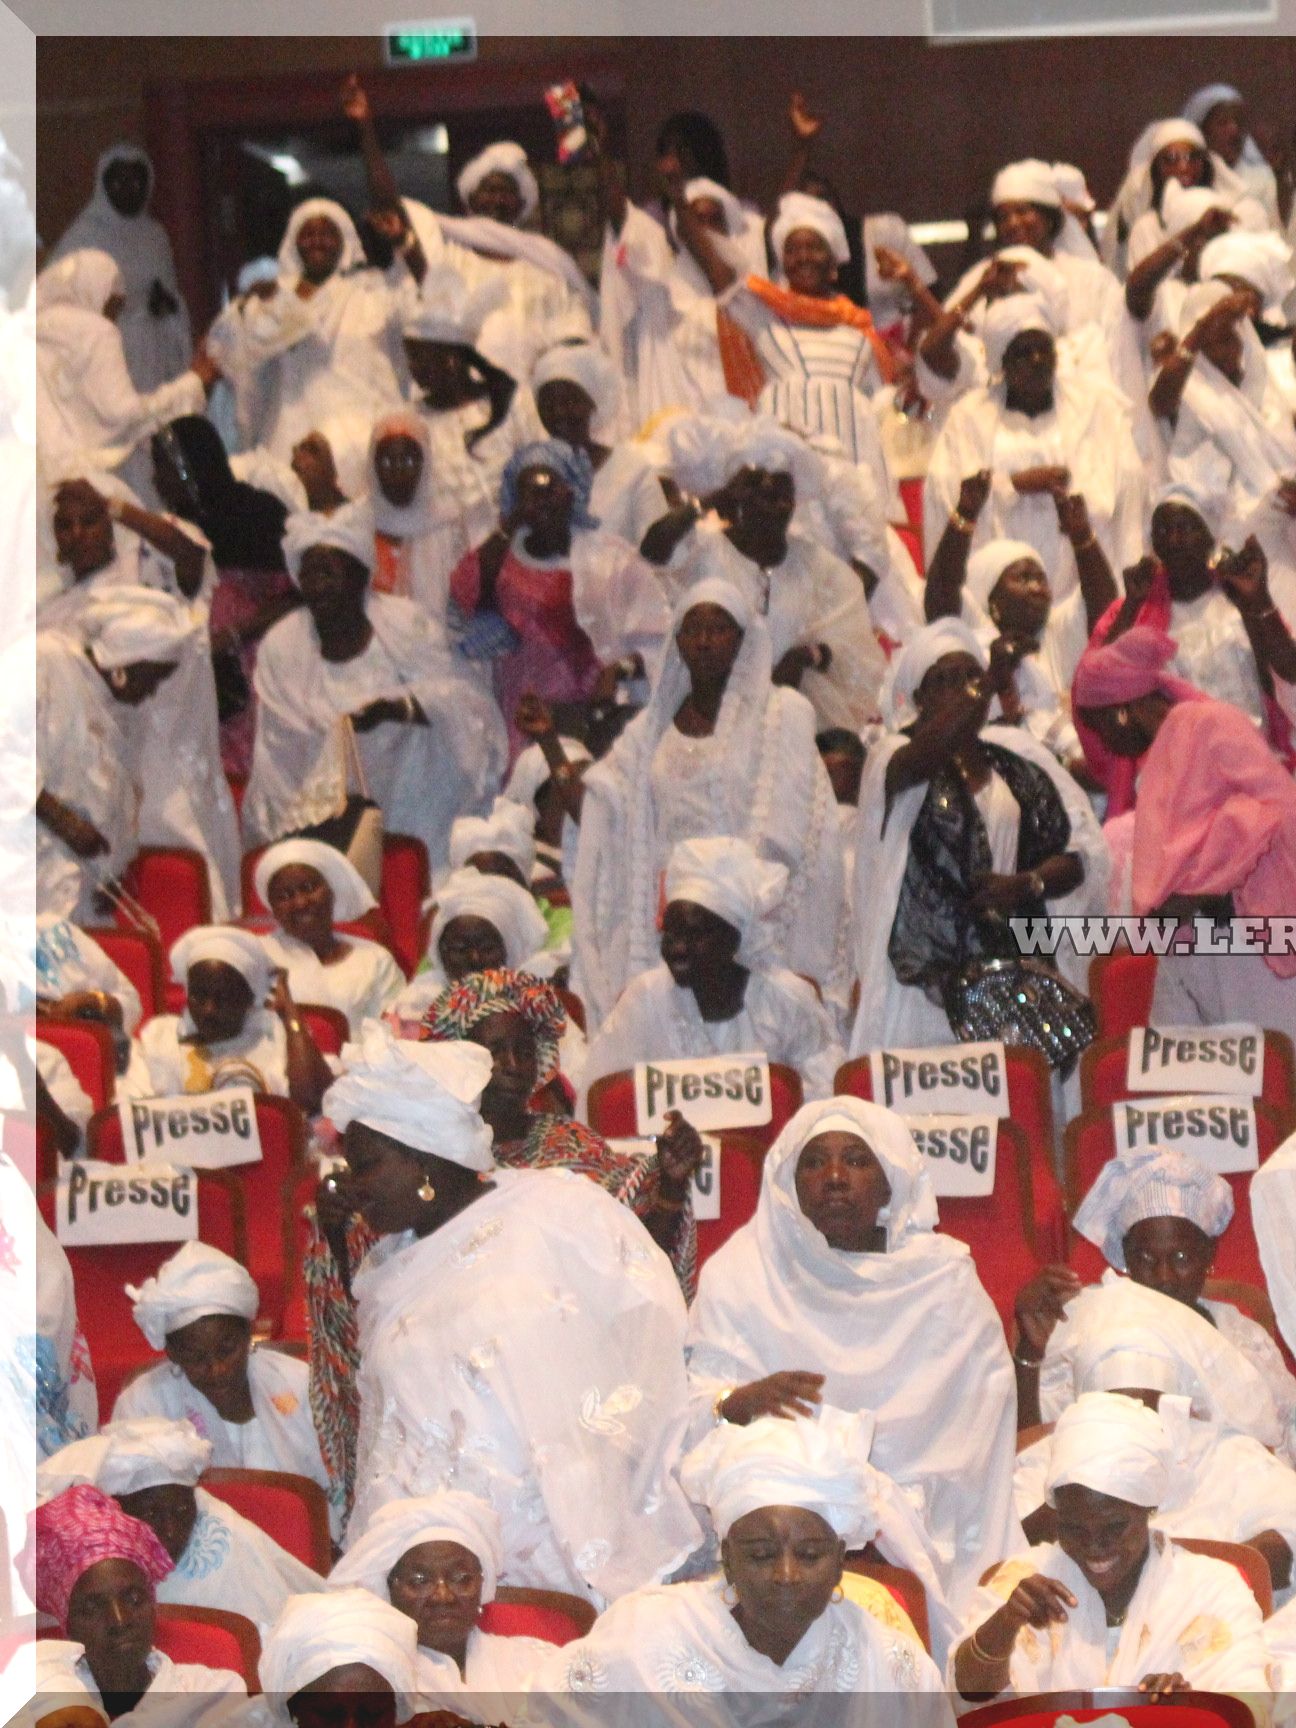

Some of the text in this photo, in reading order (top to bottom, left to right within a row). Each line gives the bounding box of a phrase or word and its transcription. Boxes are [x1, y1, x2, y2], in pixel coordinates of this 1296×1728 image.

[1141, 1027, 1258, 1075] Presse
[646, 1065, 763, 1119] Presse
[882, 1051, 1000, 1108] Presse
[131, 1098, 250, 1159] Presse
[909, 1125, 991, 1174] esse
[1125, 1104, 1250, 1149] Presse
[68, 1163, 191, 1225] Presse
